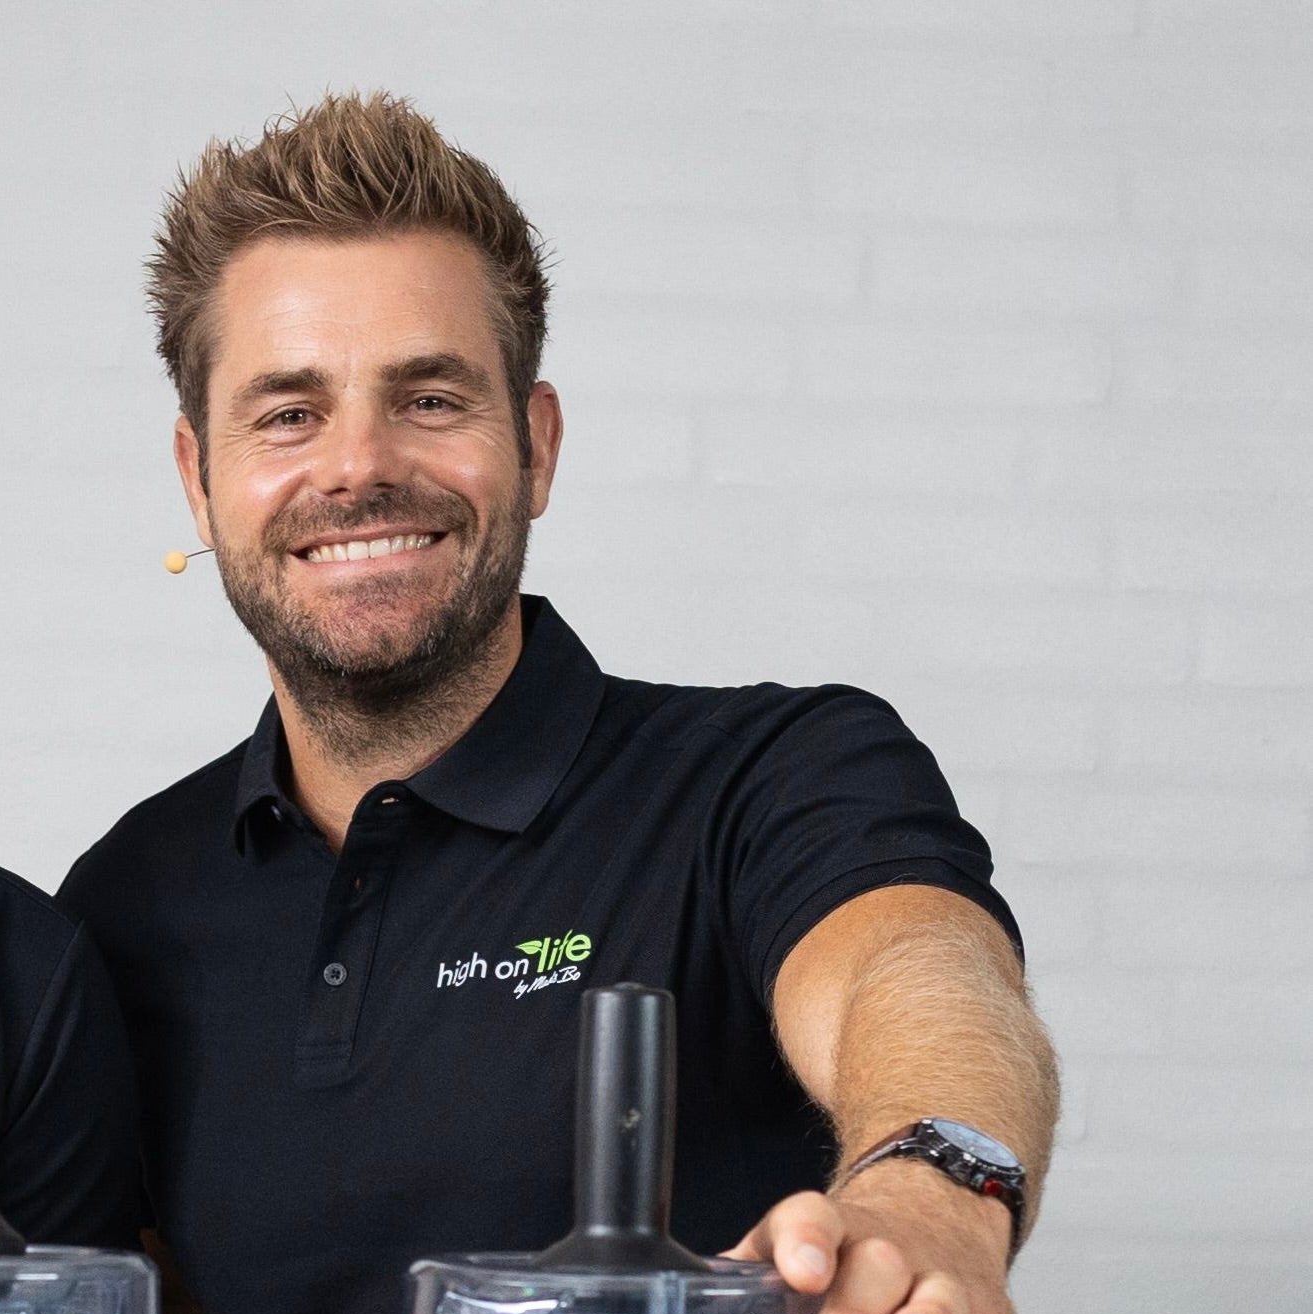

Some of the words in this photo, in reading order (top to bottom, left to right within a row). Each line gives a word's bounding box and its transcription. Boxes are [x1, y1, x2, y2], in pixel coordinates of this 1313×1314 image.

[437, 952, 486, 988] high
[495, 958, 529, 979] on
[536, 929, 592, 973] life
[513, 979, 529, 1000] by
